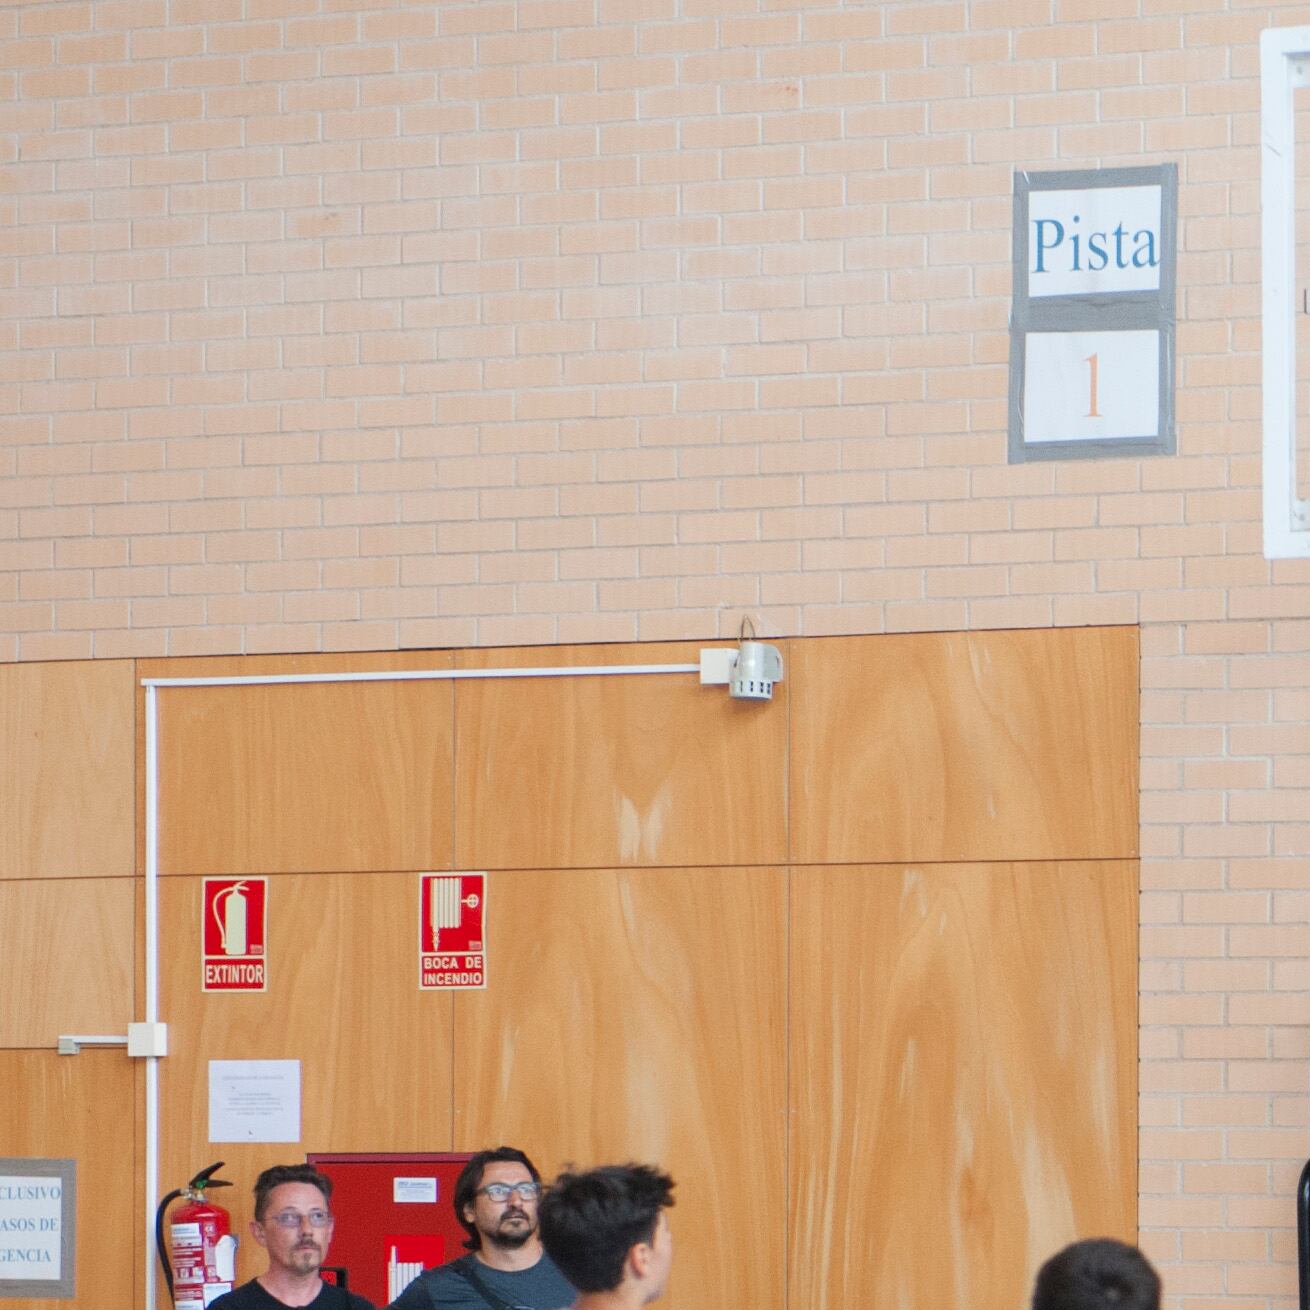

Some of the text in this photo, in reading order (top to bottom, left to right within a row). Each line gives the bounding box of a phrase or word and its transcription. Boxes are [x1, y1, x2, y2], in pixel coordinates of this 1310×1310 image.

[1031, 215, 1160, 273] Pista
[1082, 352, 1103, 417] 1
[424, 956, 482, 969] BOCA DE
[206, 965, 264, 984] EXTINTOR
[424, 972, 482, 985] INCENDIO
[40, 1218, 59, 1232] DE
